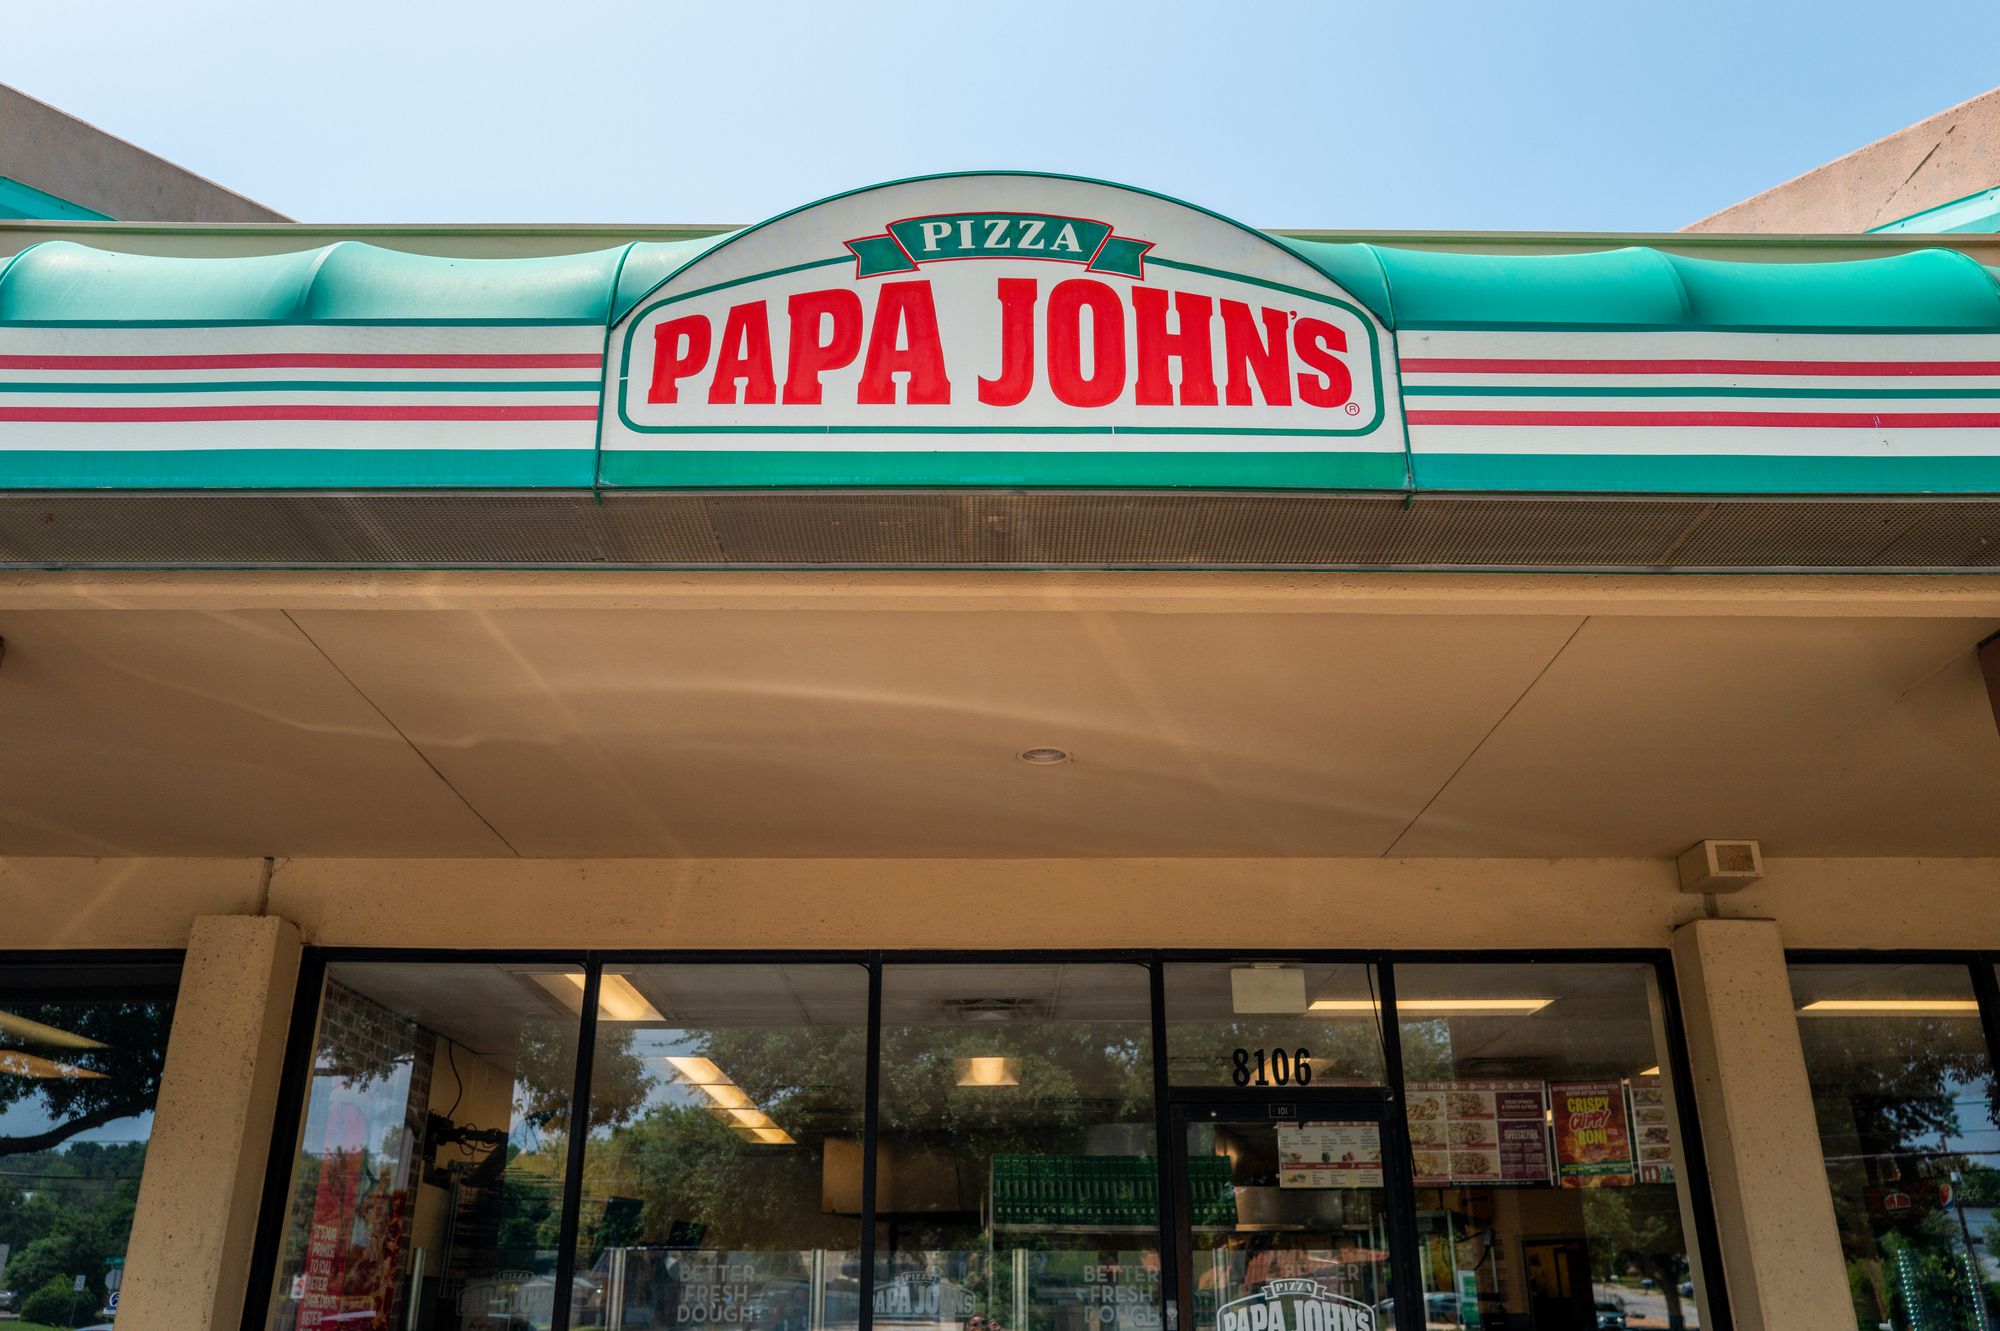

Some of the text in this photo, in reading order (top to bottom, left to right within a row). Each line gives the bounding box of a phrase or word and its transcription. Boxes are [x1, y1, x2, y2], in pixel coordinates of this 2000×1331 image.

[920, 219, 1083, 252] PIZZA
[647, 278, 953, 406] PAPA
[977, 278, 1353, 409] JOHN'S
[1232, 1047, 1312, 1087] 8106
[1567, 1096, 1610, 1113] CRISPY
[1569, 1108, 1612, 1131] CUPPY
[679, 1264, 755, 1282] BETTER
[1083, 1265, 1160, 1282] BETTER
[684, 1284, 748, 1302] FRESH
[1090, 1285, 1153, 1303] FRESH
[1275, 1280, 1313, 1293] PIZZA
[872, 1285, 912, 1314] APA
[677, 1304, 753, 1323] DOUGH
[1083, 1305, 1160, 1323] DOUGH
[1223, 1299, 1370, 1331] PAPA JOHN'S
